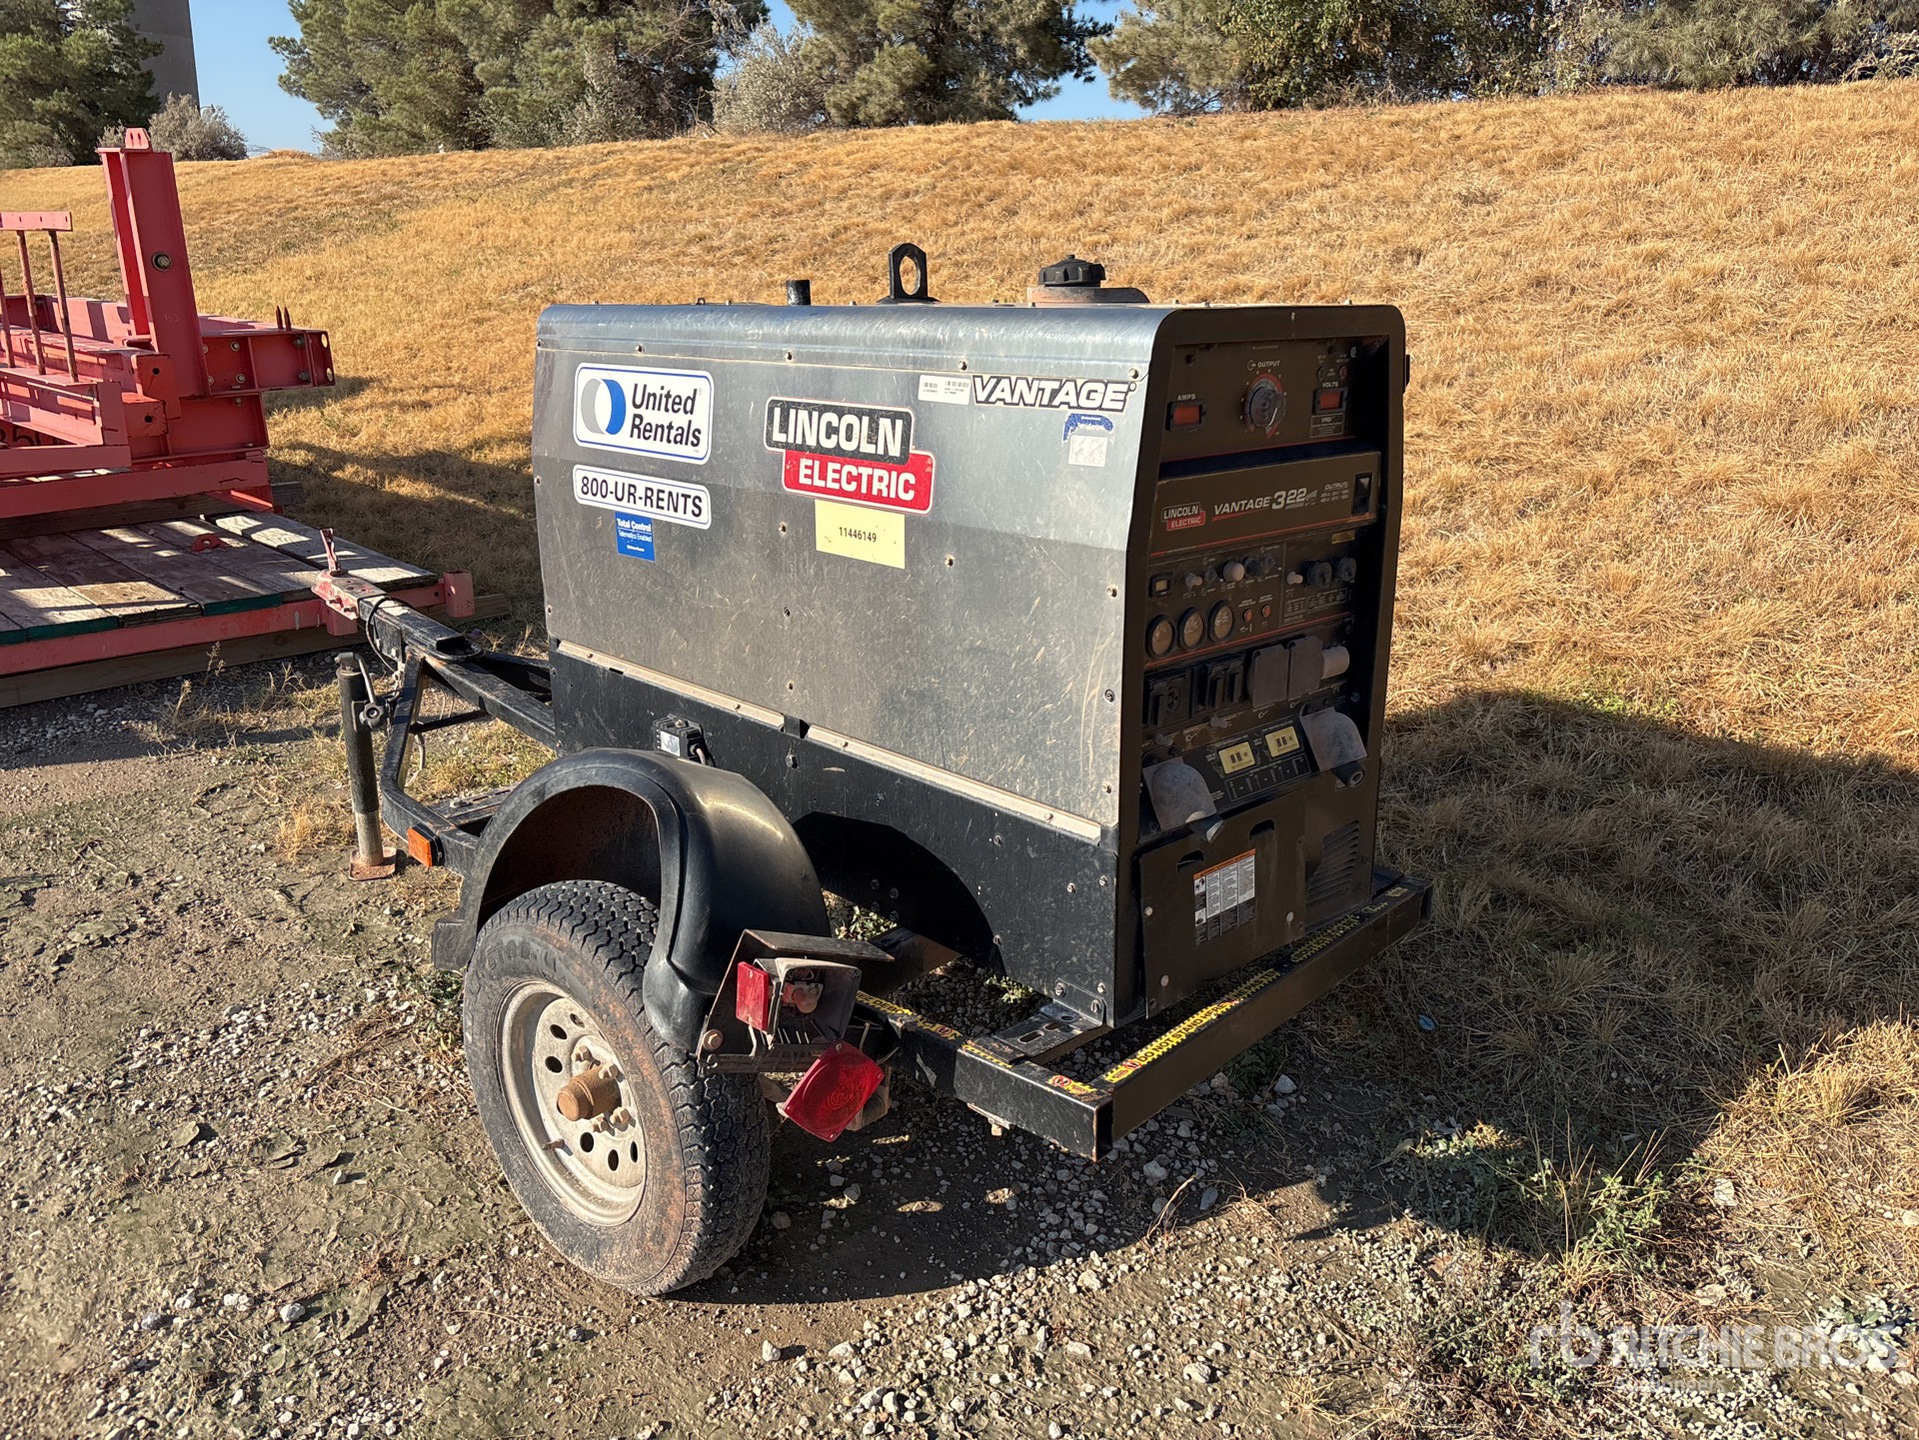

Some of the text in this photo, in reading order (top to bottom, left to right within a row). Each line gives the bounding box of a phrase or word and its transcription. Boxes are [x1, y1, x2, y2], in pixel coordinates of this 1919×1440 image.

[1257, 360, 1280, 368] OUTPUT
[632, 383, 698, 415] United
[973, 375, 1129, 412] VANTAGE
[1177, 393, 1196, 401] AMPS
[630, 413, 702, 447] Rentals
[772, 407, 903, 457] LINCOLN
[799, 458, 916, 501] ELECTRIC
[581, 476, 703, 517] 800-UR-RENTS
[1213, 496, 1271, 515] VANTAGE
[1271, 487, 1307, 510] 322
[617, 518, 652, 532] Total Control
[1163, 505, 1198, 520] LINCOLN
[1171, 516, 1201, 528] ELECTRIC
[839, 527, 877, 543] 11446149
[1138, 1003, 1227, 1062] DO NOT STAND HERE
